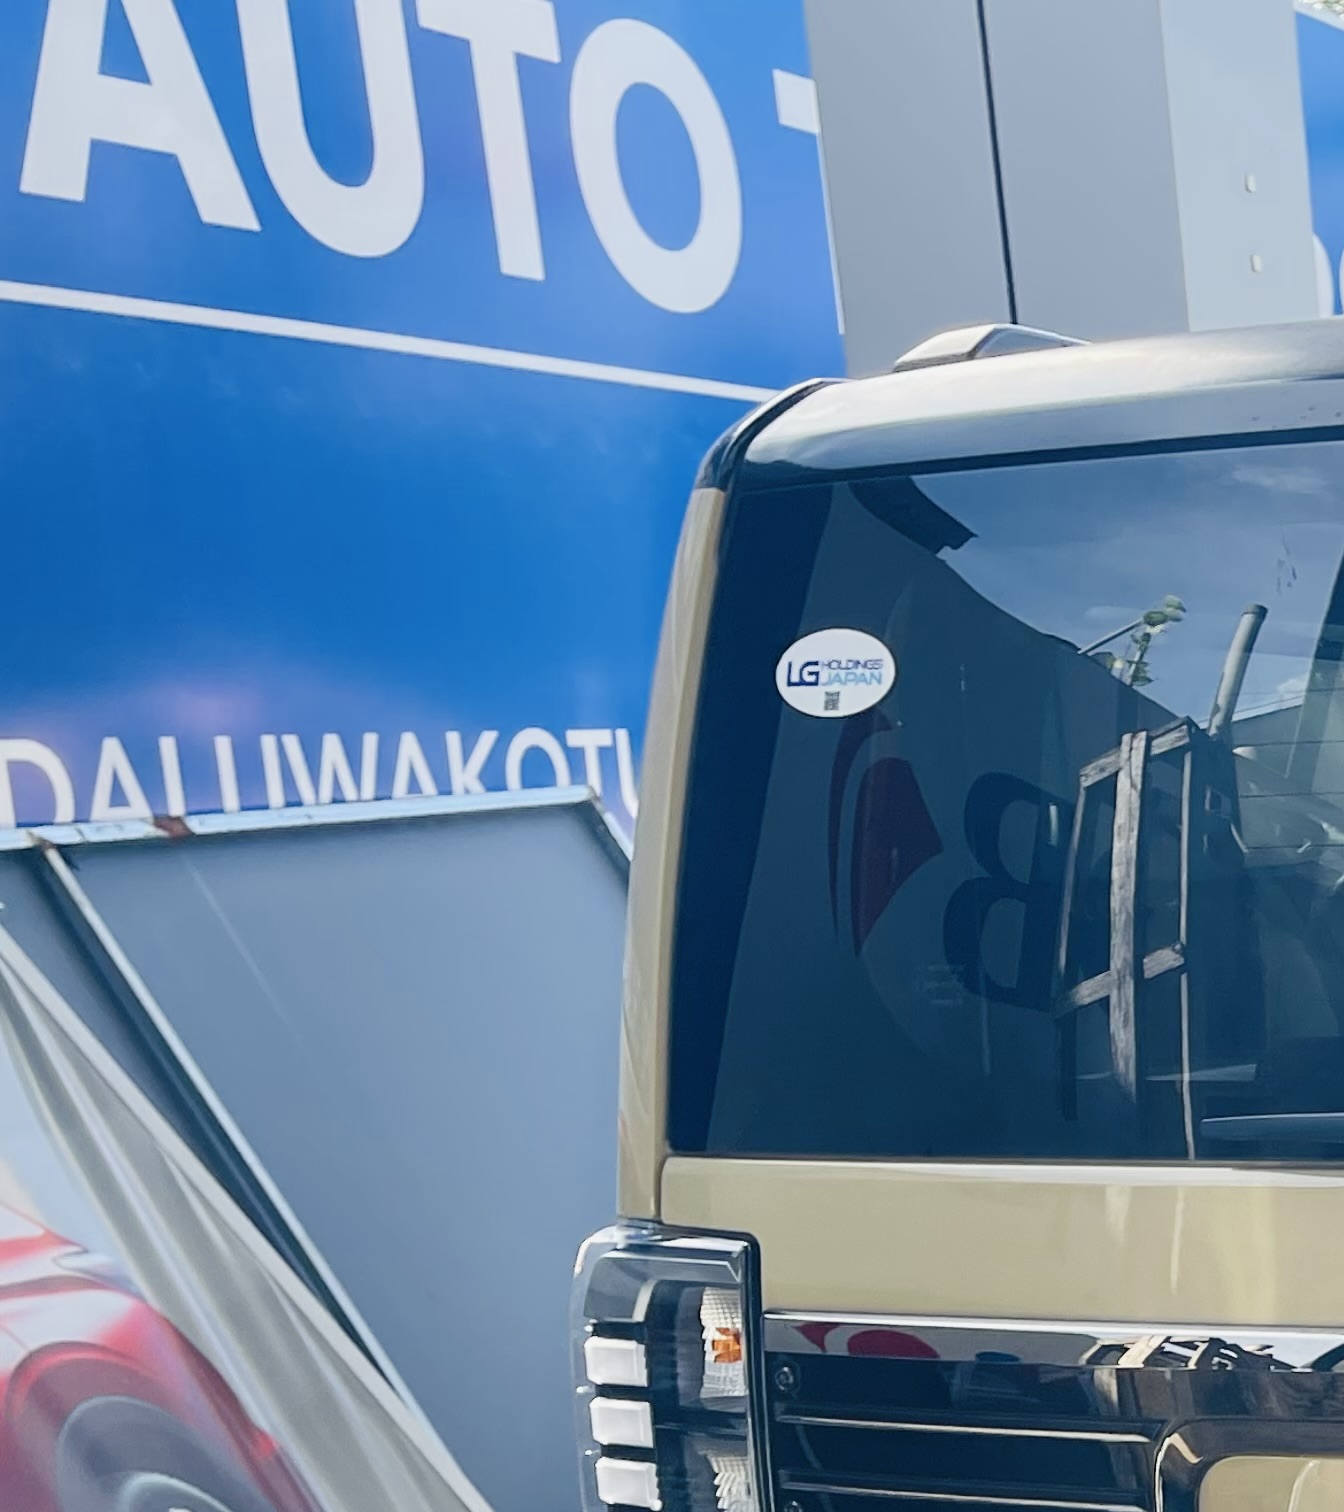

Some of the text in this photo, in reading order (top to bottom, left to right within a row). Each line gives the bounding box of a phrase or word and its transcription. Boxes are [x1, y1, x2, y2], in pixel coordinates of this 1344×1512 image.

[19, 0, 744, 314] AUTO
[786, 661, 820, 687] LG
[820, 671, 883, 686] JAPAN
